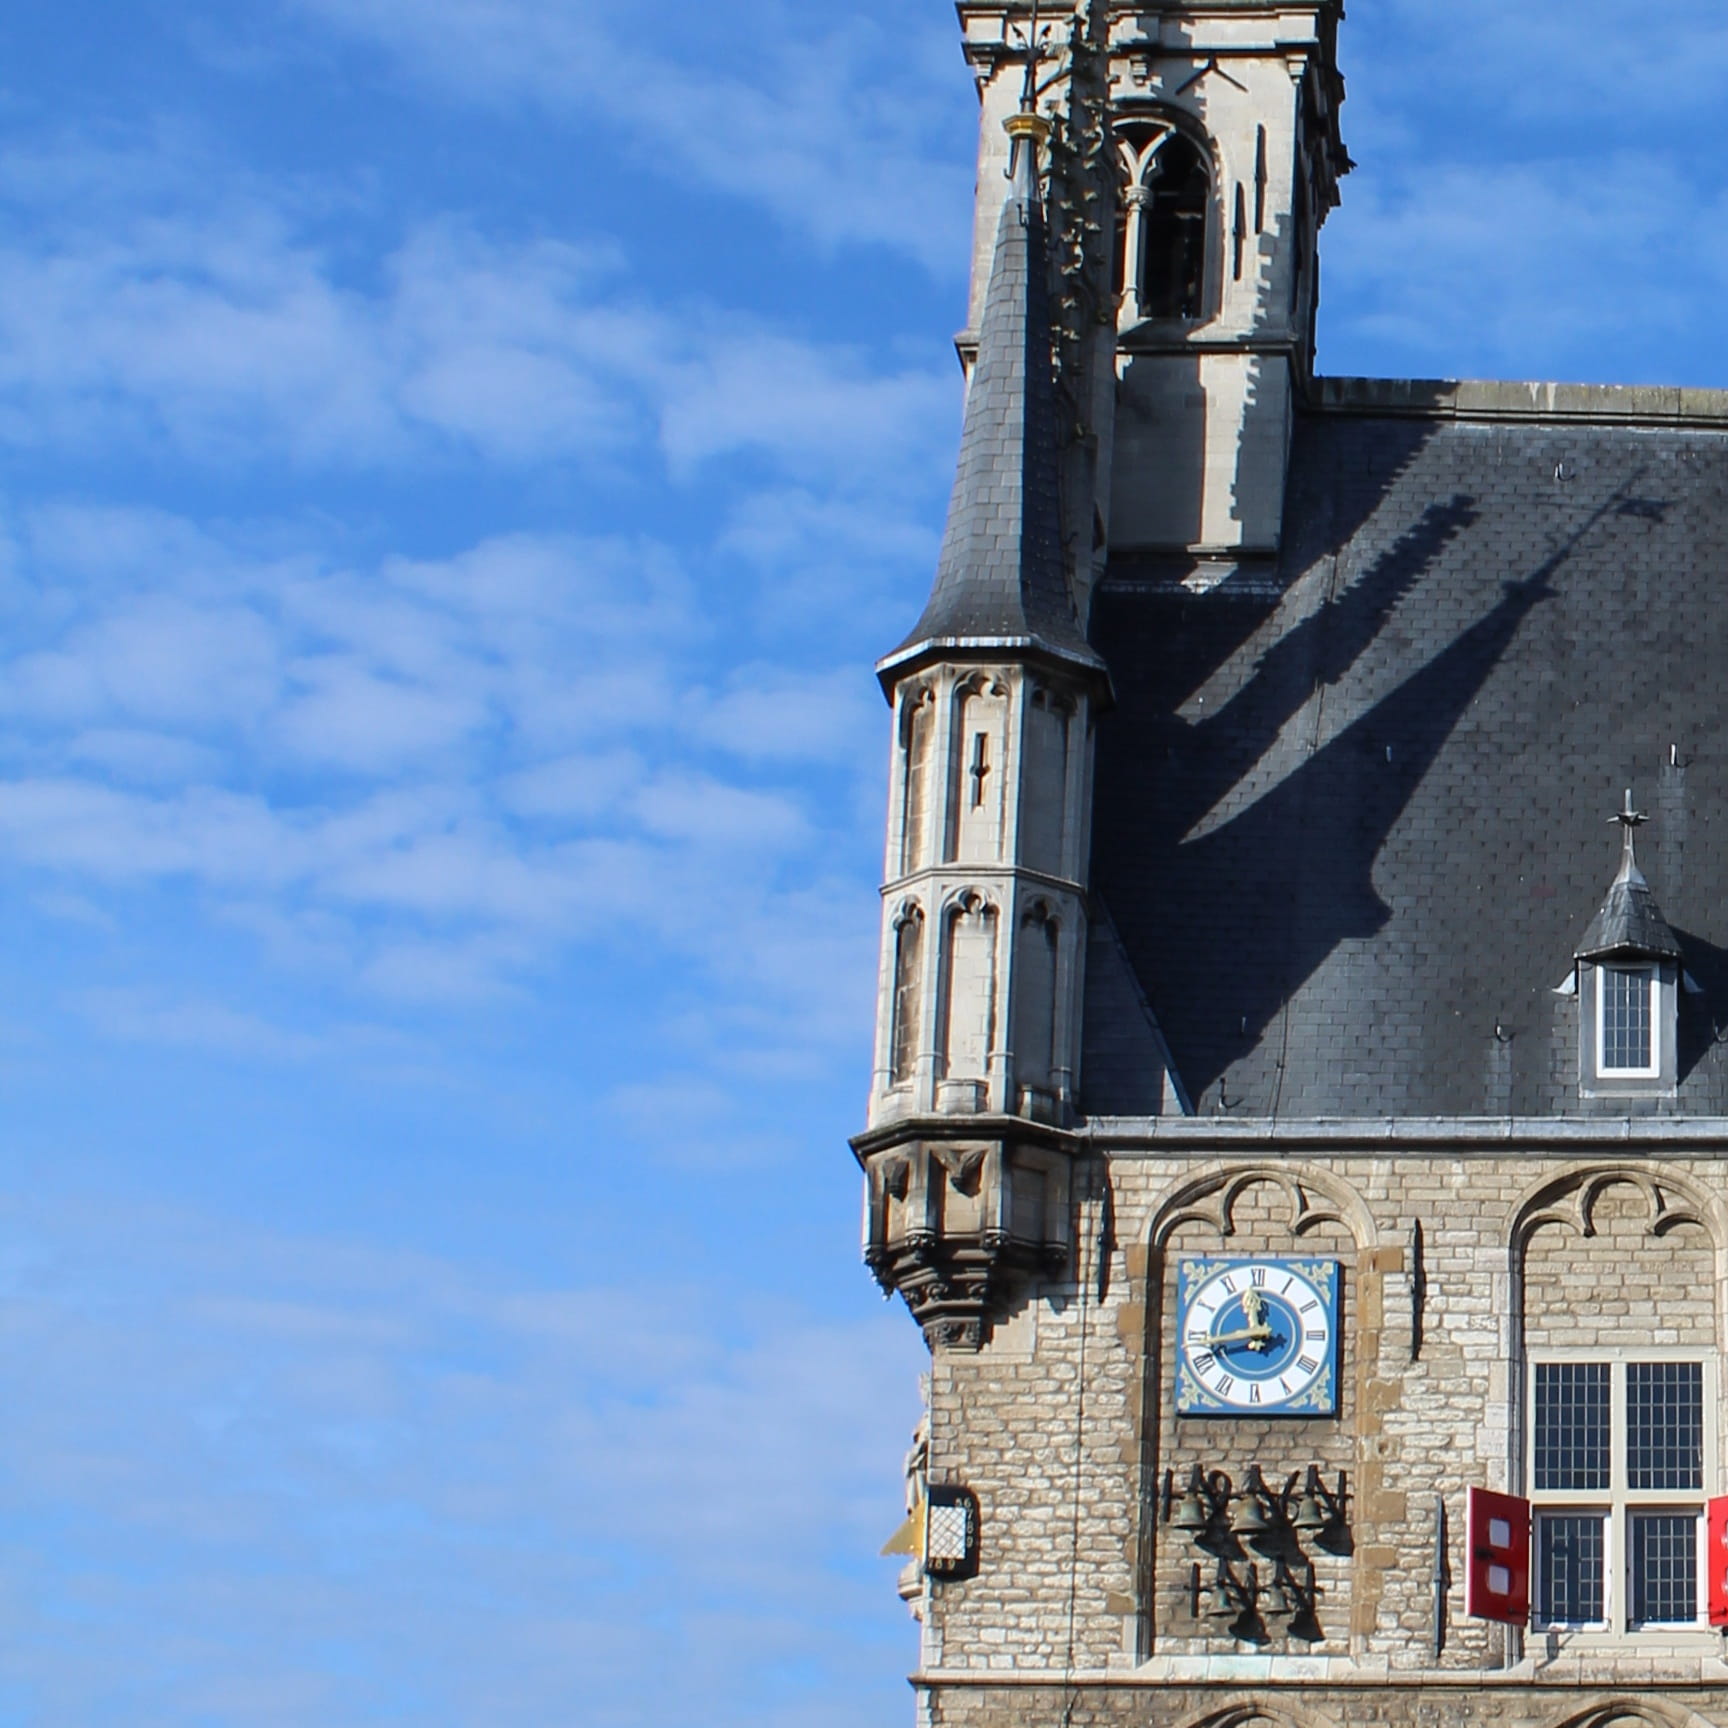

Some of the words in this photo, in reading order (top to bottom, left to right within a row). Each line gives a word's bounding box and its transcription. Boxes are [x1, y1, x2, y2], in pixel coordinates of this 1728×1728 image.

[1220, 1275, 1236, 1295] XI
[1251, 1268, 1265, 1287] XII
[1281, 1277, 1294, 1295] I
[1299, 1299, 1319, 1314] II
[1306, 1330, 1326, 1341] III
[1296, 1355, 1319, 1375] IIII
[1214, 1374, 1234, 1396] VII
[1250, 1384, 1260, 1403] VI
[1279, 1376, 1292, 1396] V
[967, 1521, 974, 1534] 8
[967, 1536, 974, 1549] 9
